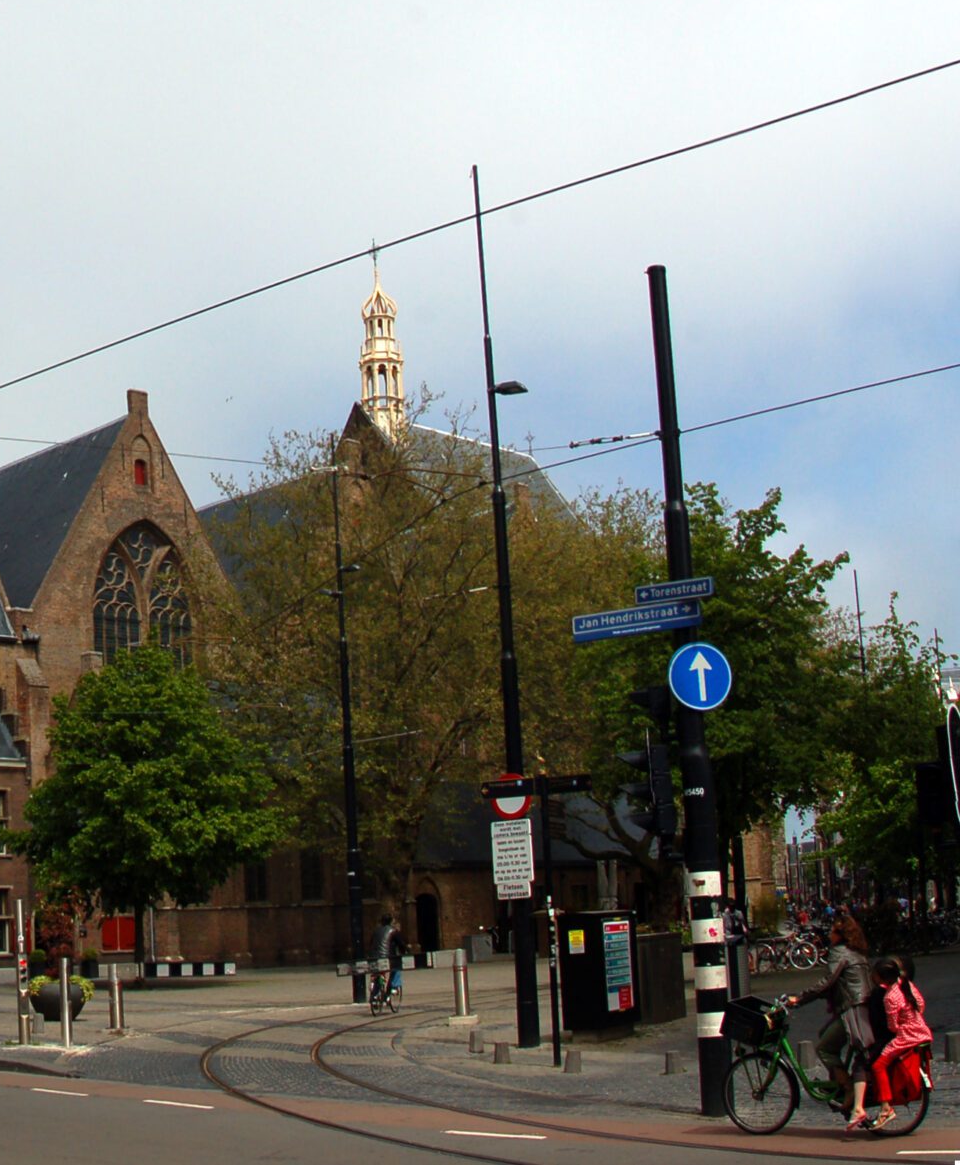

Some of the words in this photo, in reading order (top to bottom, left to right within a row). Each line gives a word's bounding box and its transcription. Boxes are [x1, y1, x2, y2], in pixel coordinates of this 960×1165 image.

[650, 582, 707, 596] Torenstraat
[579, 618, 599, 629] Jan
[601, 605, 679, 625] Hendrikstraat
